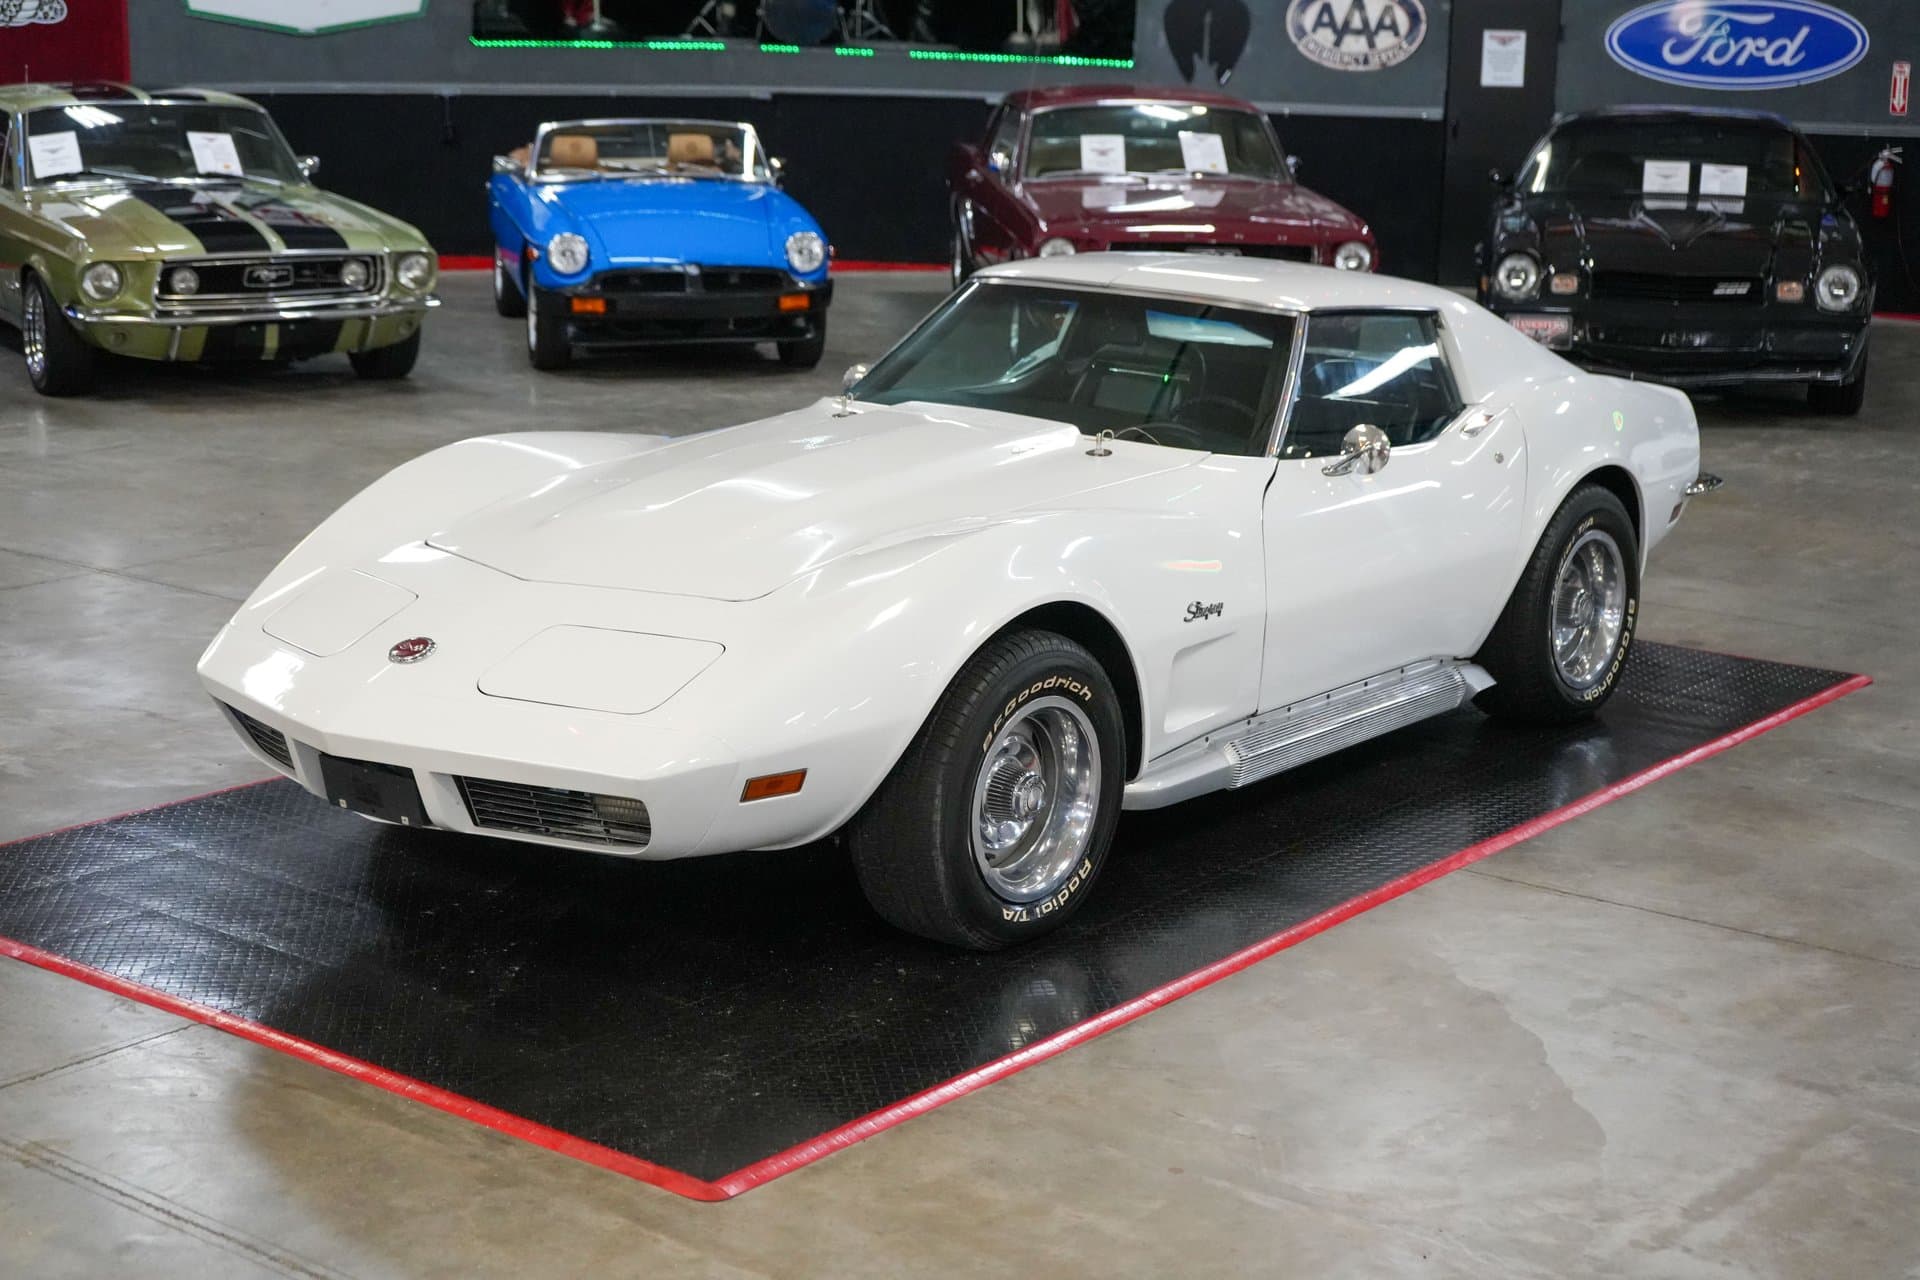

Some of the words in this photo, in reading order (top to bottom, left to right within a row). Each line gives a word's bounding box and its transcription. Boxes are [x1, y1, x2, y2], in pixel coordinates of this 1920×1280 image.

[1311, 0, 1400, 48] AAA
[1661, 9, 1810, 67] Ford
[1002, 907, 1030, 922] T/A
[1035, 859, 1092, 918] Radial
